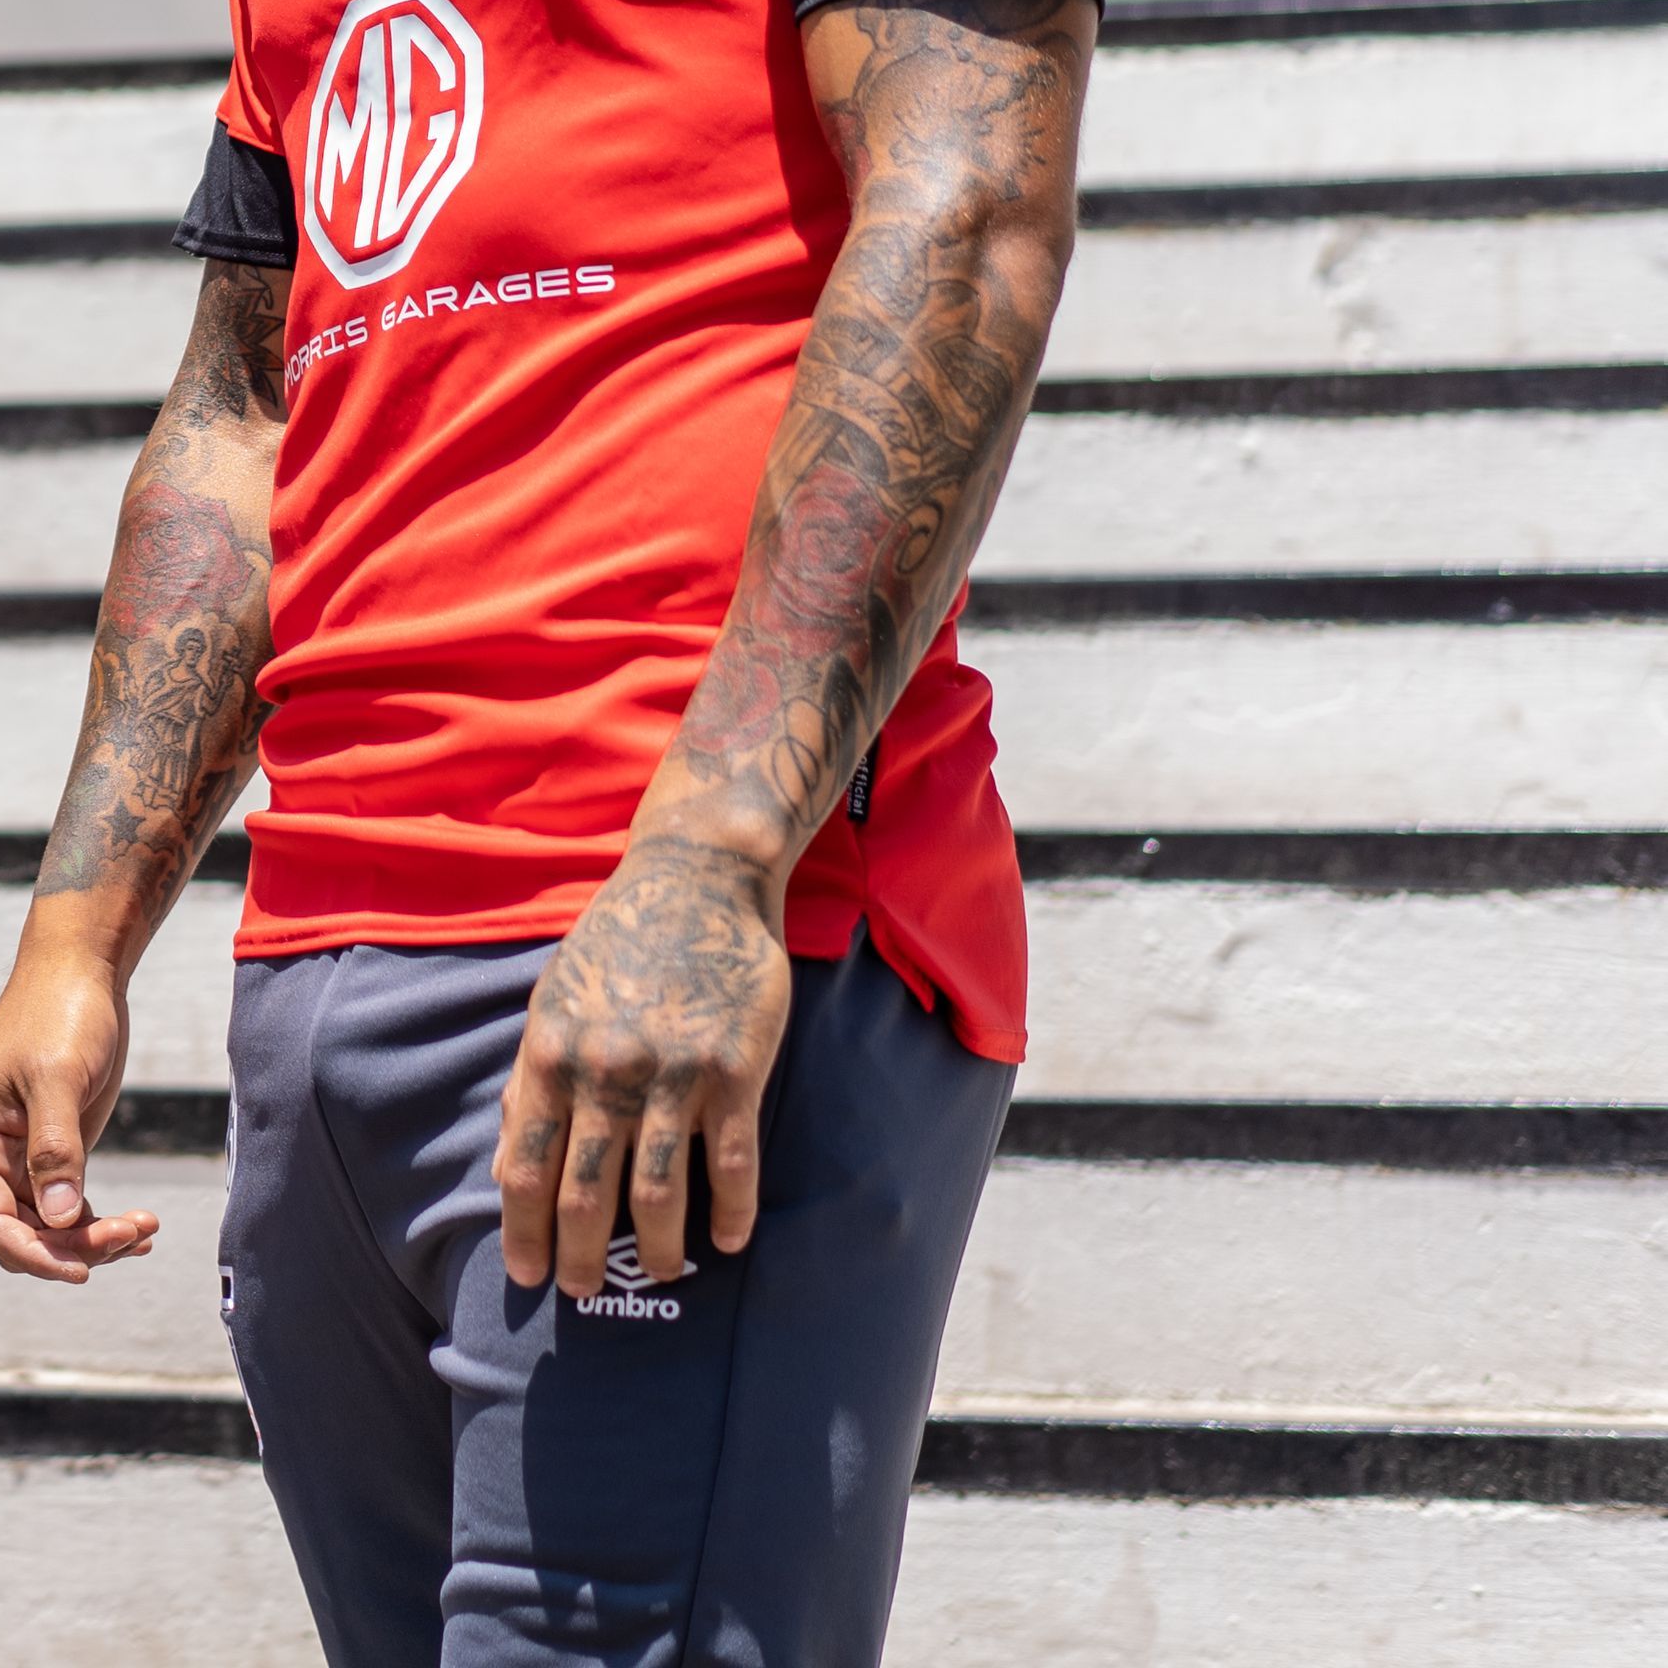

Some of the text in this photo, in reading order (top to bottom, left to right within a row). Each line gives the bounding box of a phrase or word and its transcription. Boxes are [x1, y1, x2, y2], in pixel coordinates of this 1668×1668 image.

[319, 14, 456, 249] MG
[284, 265, 615, 398] MORRIS GARAGES
[576, 1291, 681, 1321] umbro
